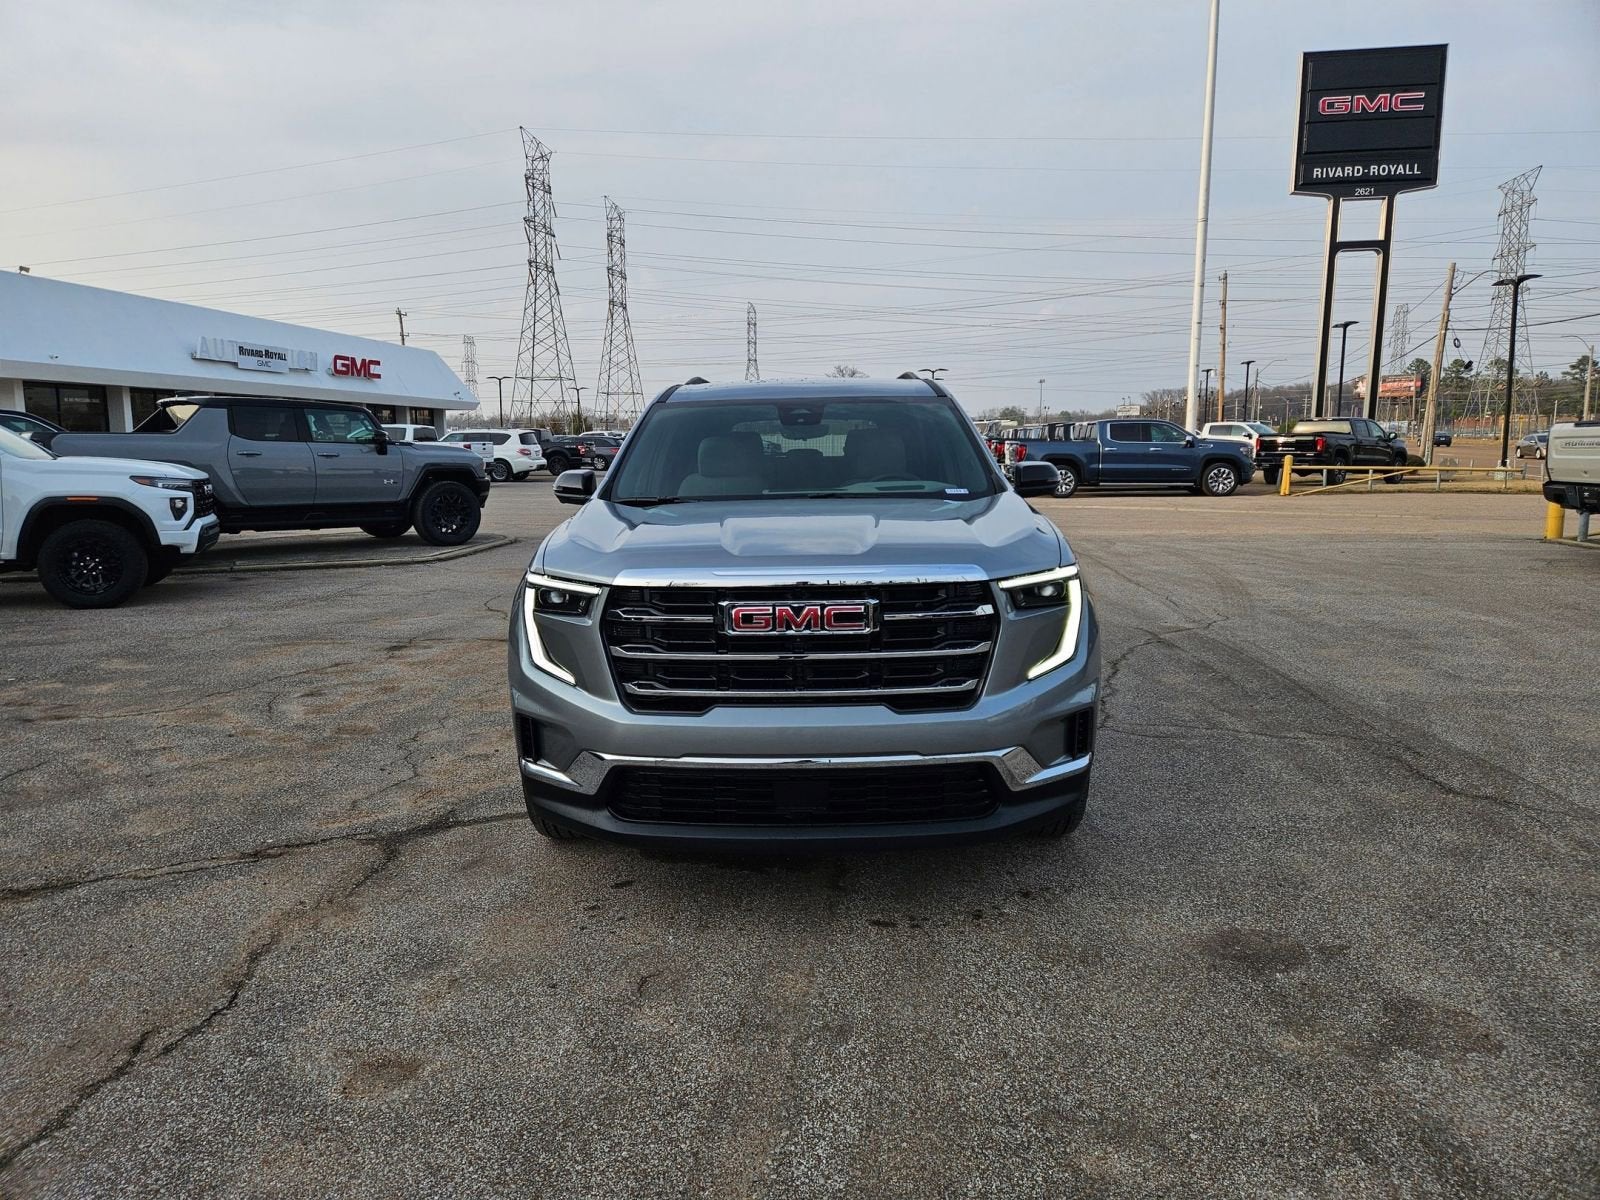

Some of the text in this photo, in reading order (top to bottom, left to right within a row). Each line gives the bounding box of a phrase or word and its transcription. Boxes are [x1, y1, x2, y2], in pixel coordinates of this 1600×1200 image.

[1318, 92, 1425, 115] GMC
[1313, 163, 1421, 178] RIVARD-ROYALL
[1355, 187, 1375, 196] 2621
[257, 360, 272, 368] GMC
[333, 354, 382, 379] GMC
[732, 606, 866, 631] GMC
